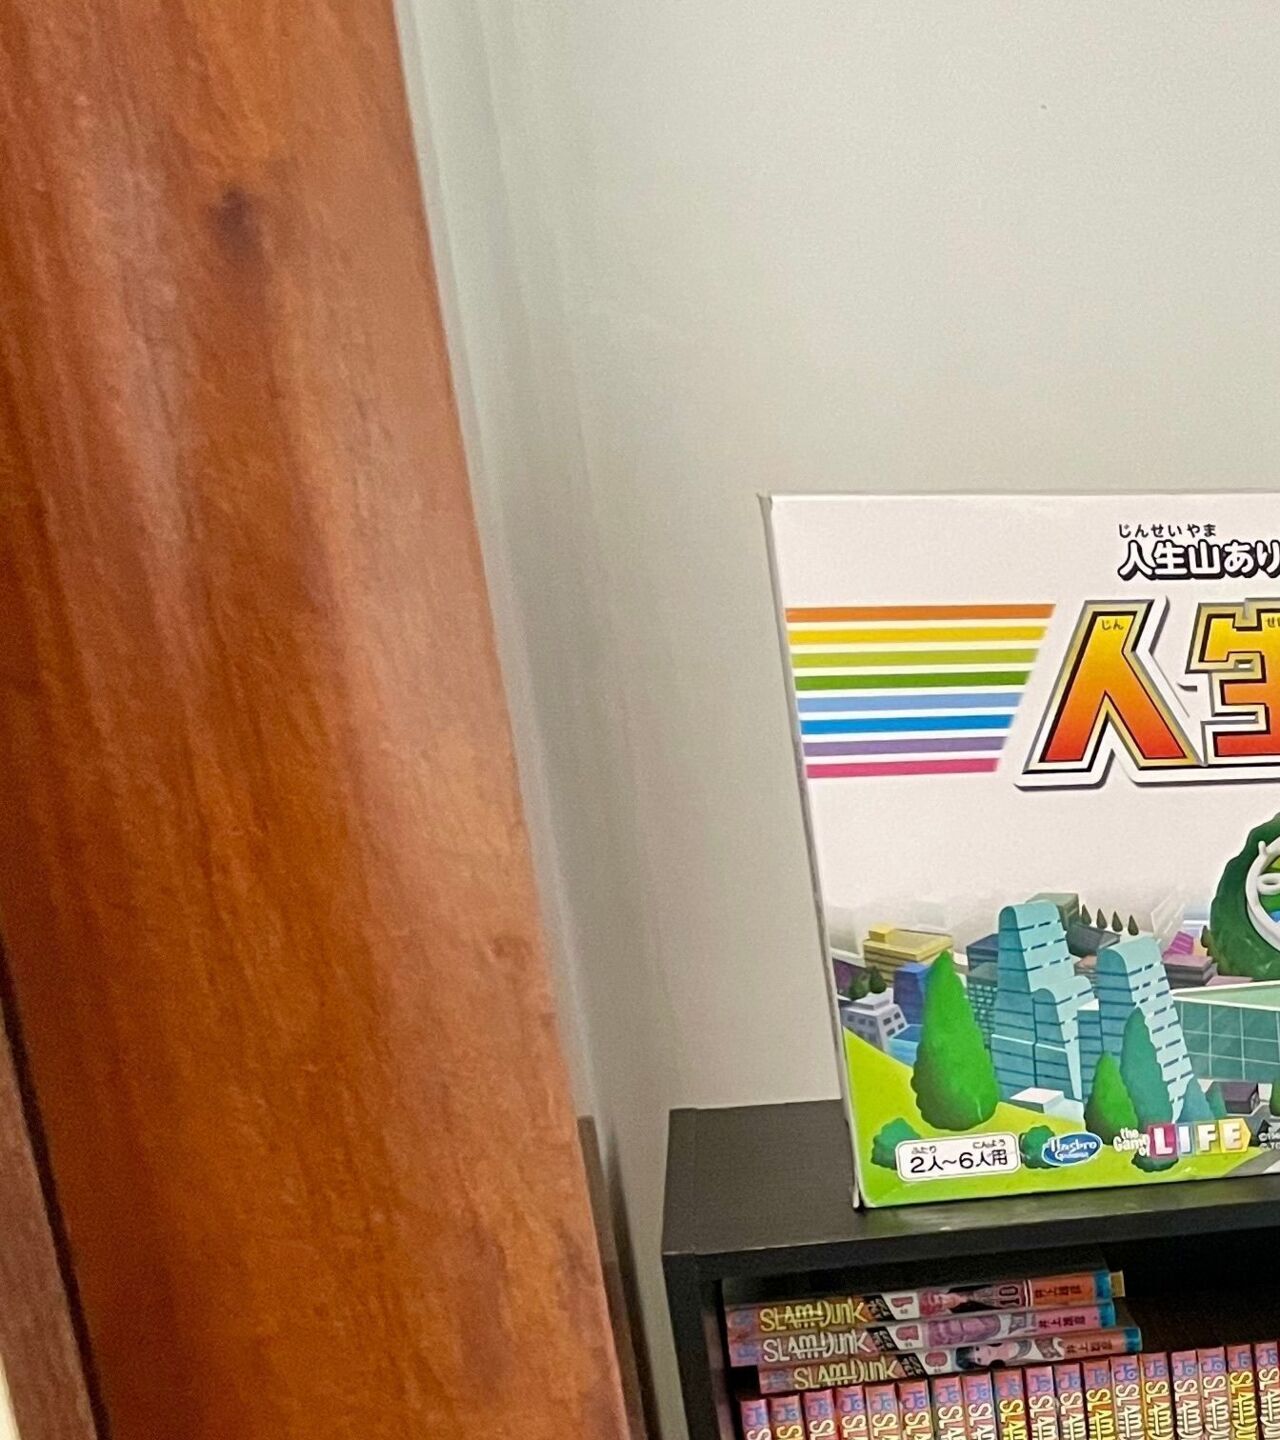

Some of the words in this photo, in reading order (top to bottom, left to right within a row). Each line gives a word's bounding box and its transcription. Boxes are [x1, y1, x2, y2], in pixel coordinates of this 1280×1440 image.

[1120, 1127, 1139, 1140] the
[1153, 1123, 1242, 1155] LIFE
[1048, 1137, 1098, 1151] Hasbro
